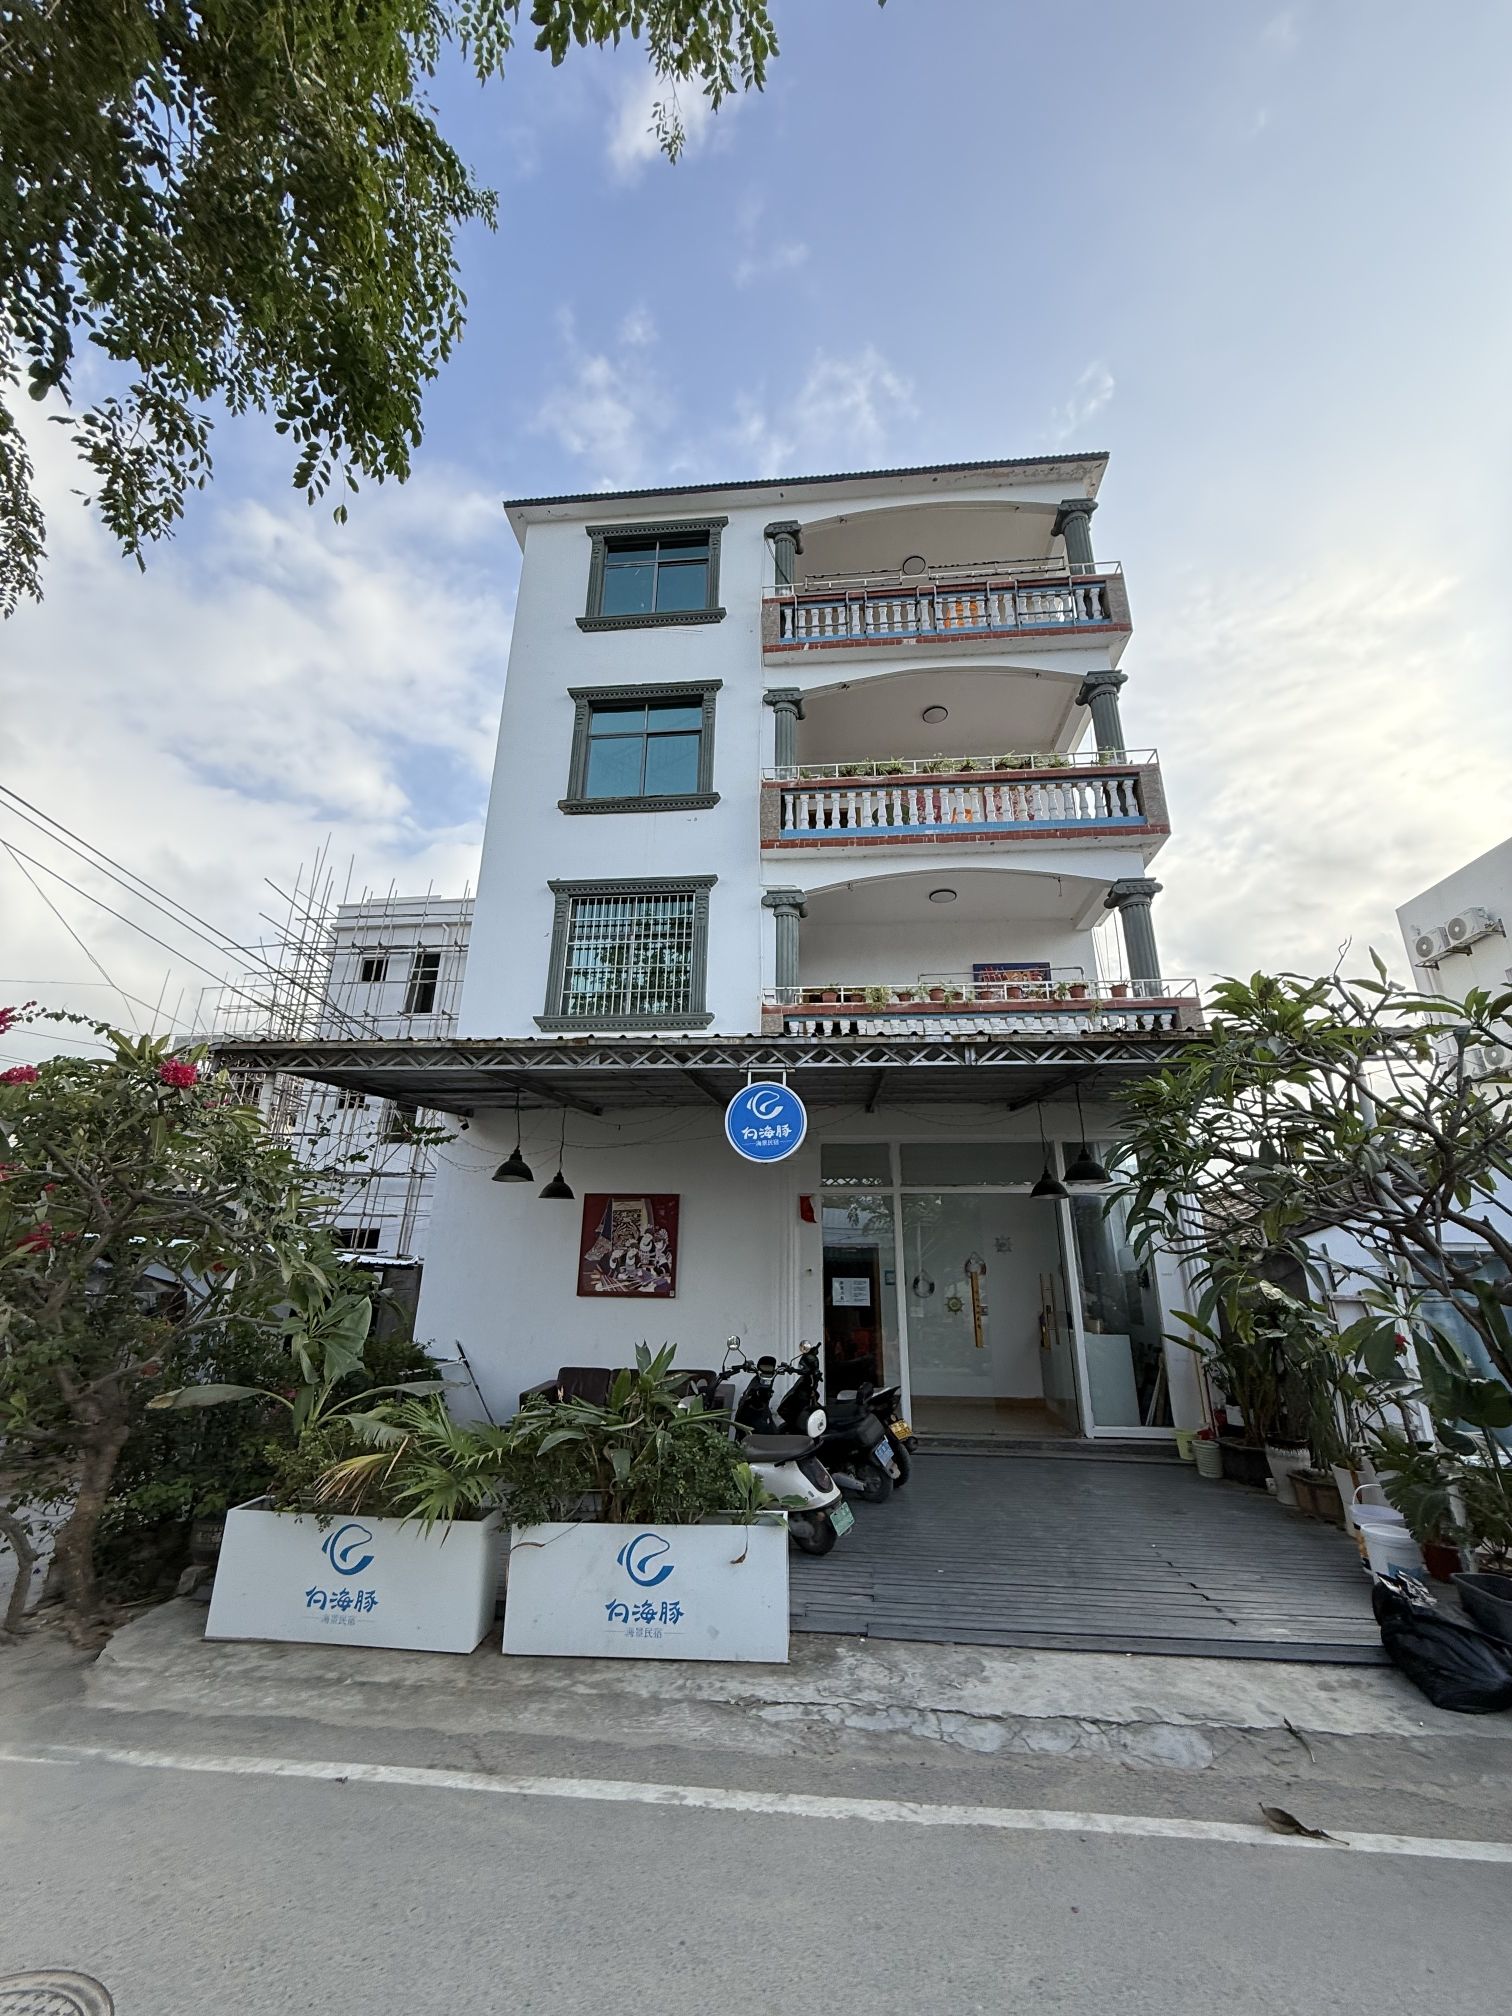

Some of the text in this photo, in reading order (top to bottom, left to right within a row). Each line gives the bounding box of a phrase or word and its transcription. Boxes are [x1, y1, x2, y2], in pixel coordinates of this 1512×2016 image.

[741, 1123, 793, 1140] 向海豚
[305, 1585, 379, 1613] 向海豚
[605, 1598, 685, 1625] 向海豚
